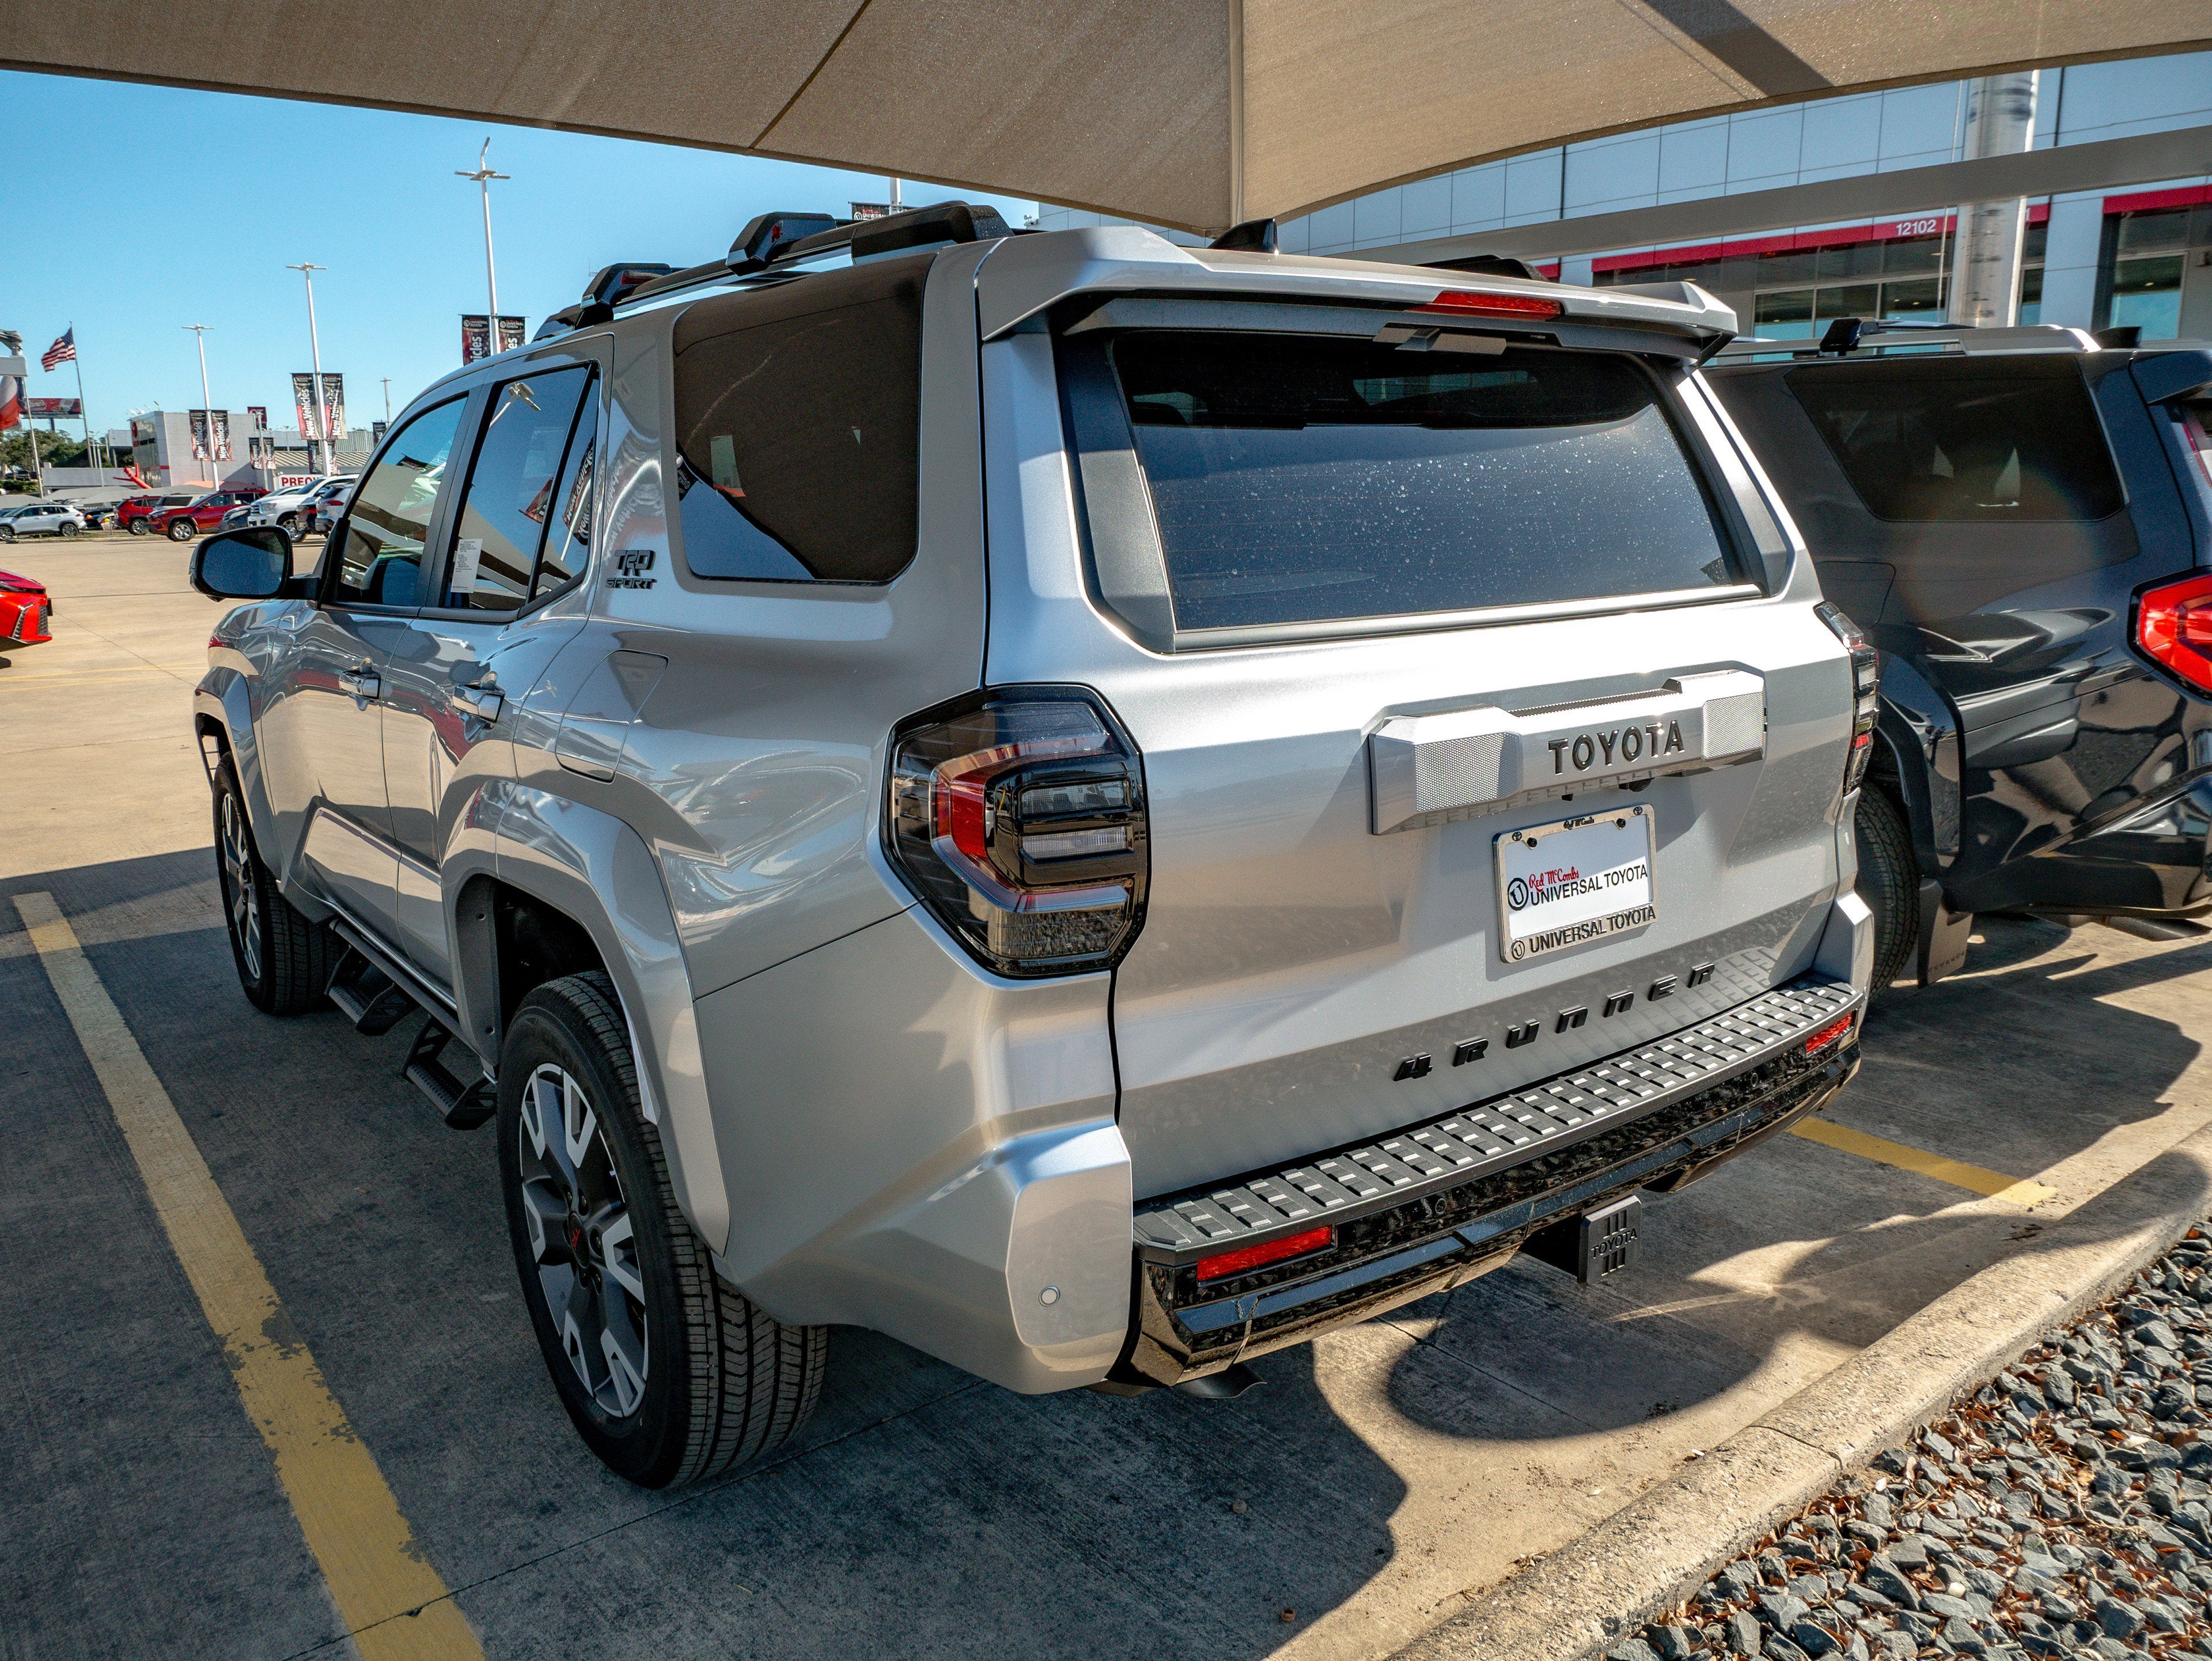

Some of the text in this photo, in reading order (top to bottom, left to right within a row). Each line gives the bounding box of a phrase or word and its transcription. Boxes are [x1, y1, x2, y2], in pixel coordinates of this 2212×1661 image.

[1896, 220, 1936, 236] 12102
[300, 388, 313, 419] Vehicles
[328, 389, 339, 418] Vehicles
[194, 422, 203, 445] Vehicles
[217, 422, 225, 445] Vehicles
[305, 420, 315, 436] New
[332, 420, 342, 436] New
[197, 445, 205, 459] New
[219, 445, 228, 459] New
[281, 477, 319, 486] PREO
[614, 550, 656, 576] TRD
[605, 578, 657, 589] SPORT
[1548, 720, 1685, 775] TOYOTA
[1529, 866, 1580, 892] Red McCombs
[1530, 864, 1648, 906] UNIVERSAL TOYOTA
[1528, 904, 1656, 953] UNIVERSAL TOYOTA
[1590, 1228, 1638, 1259] TOYOTA
